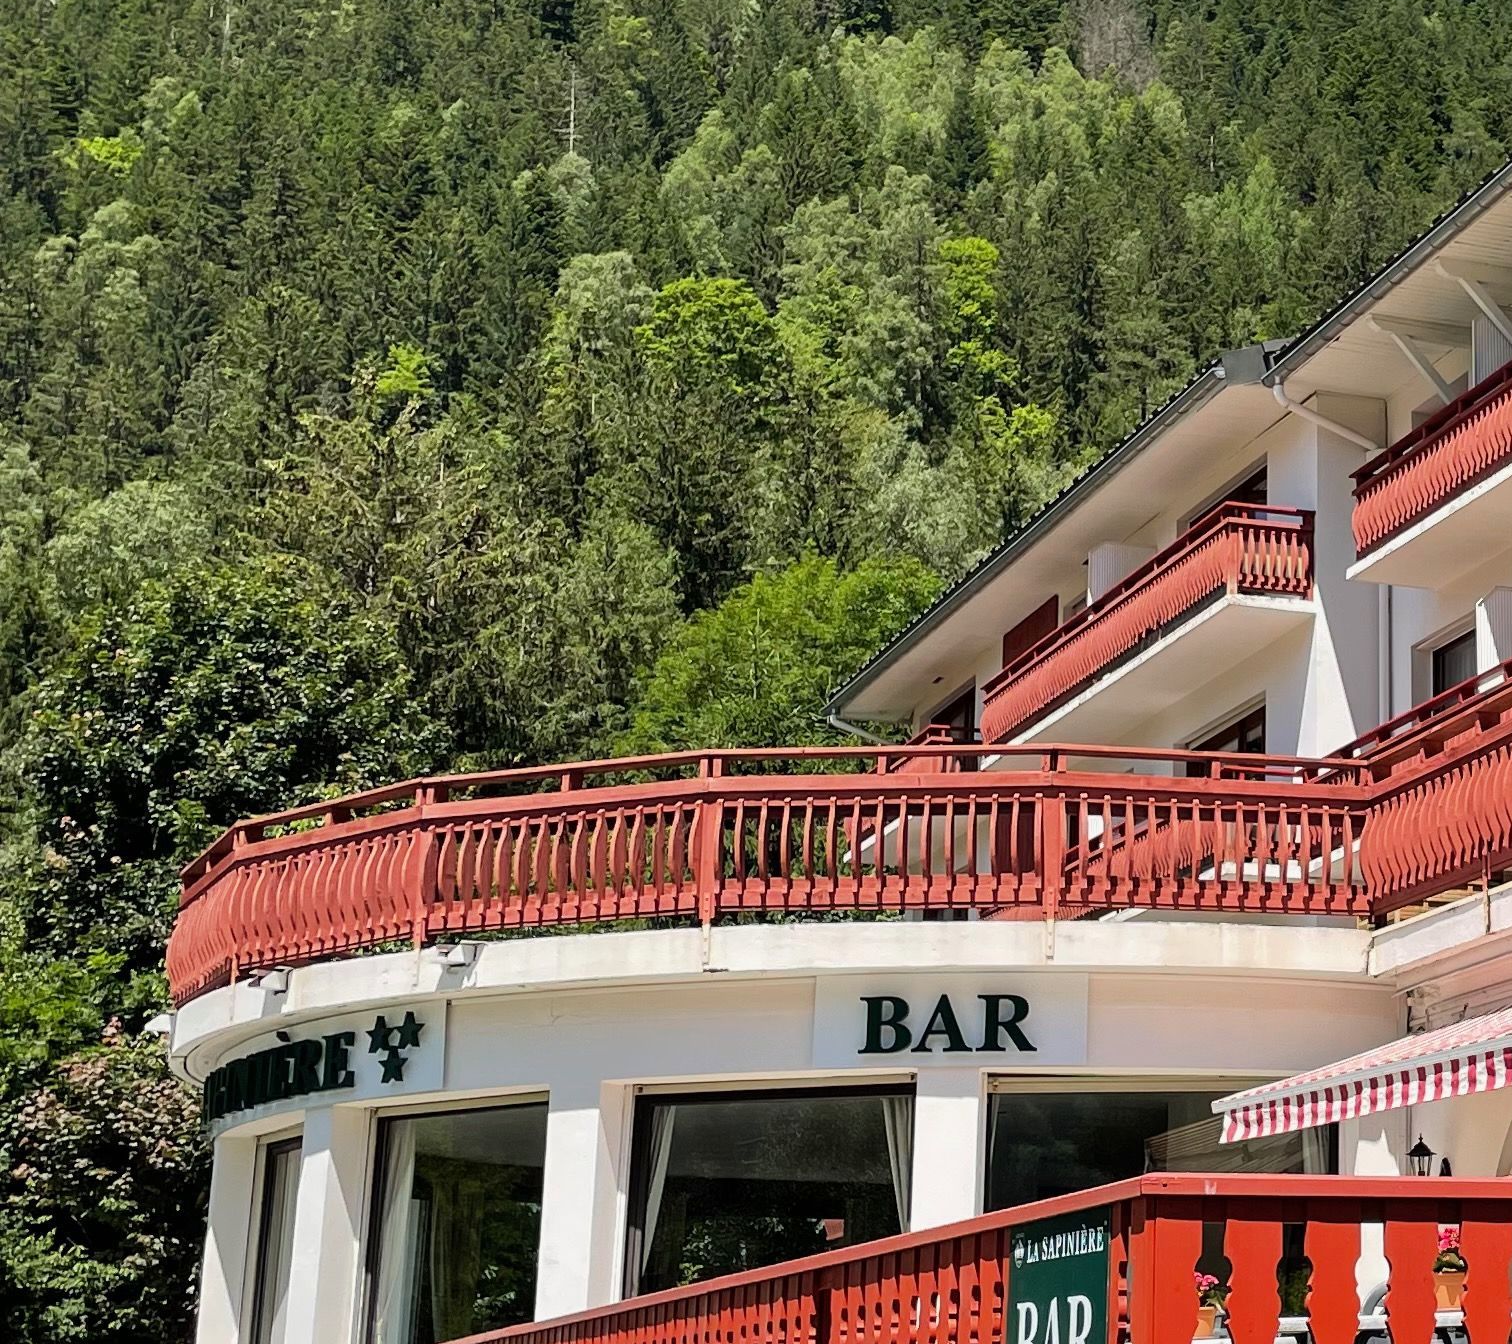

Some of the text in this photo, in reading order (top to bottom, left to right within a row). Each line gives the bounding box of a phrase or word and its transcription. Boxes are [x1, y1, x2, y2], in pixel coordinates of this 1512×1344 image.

[858, 993, 1038, 1054] BAR
[1026, 1223, 1105, 1264] LA SAPINIÈRE
